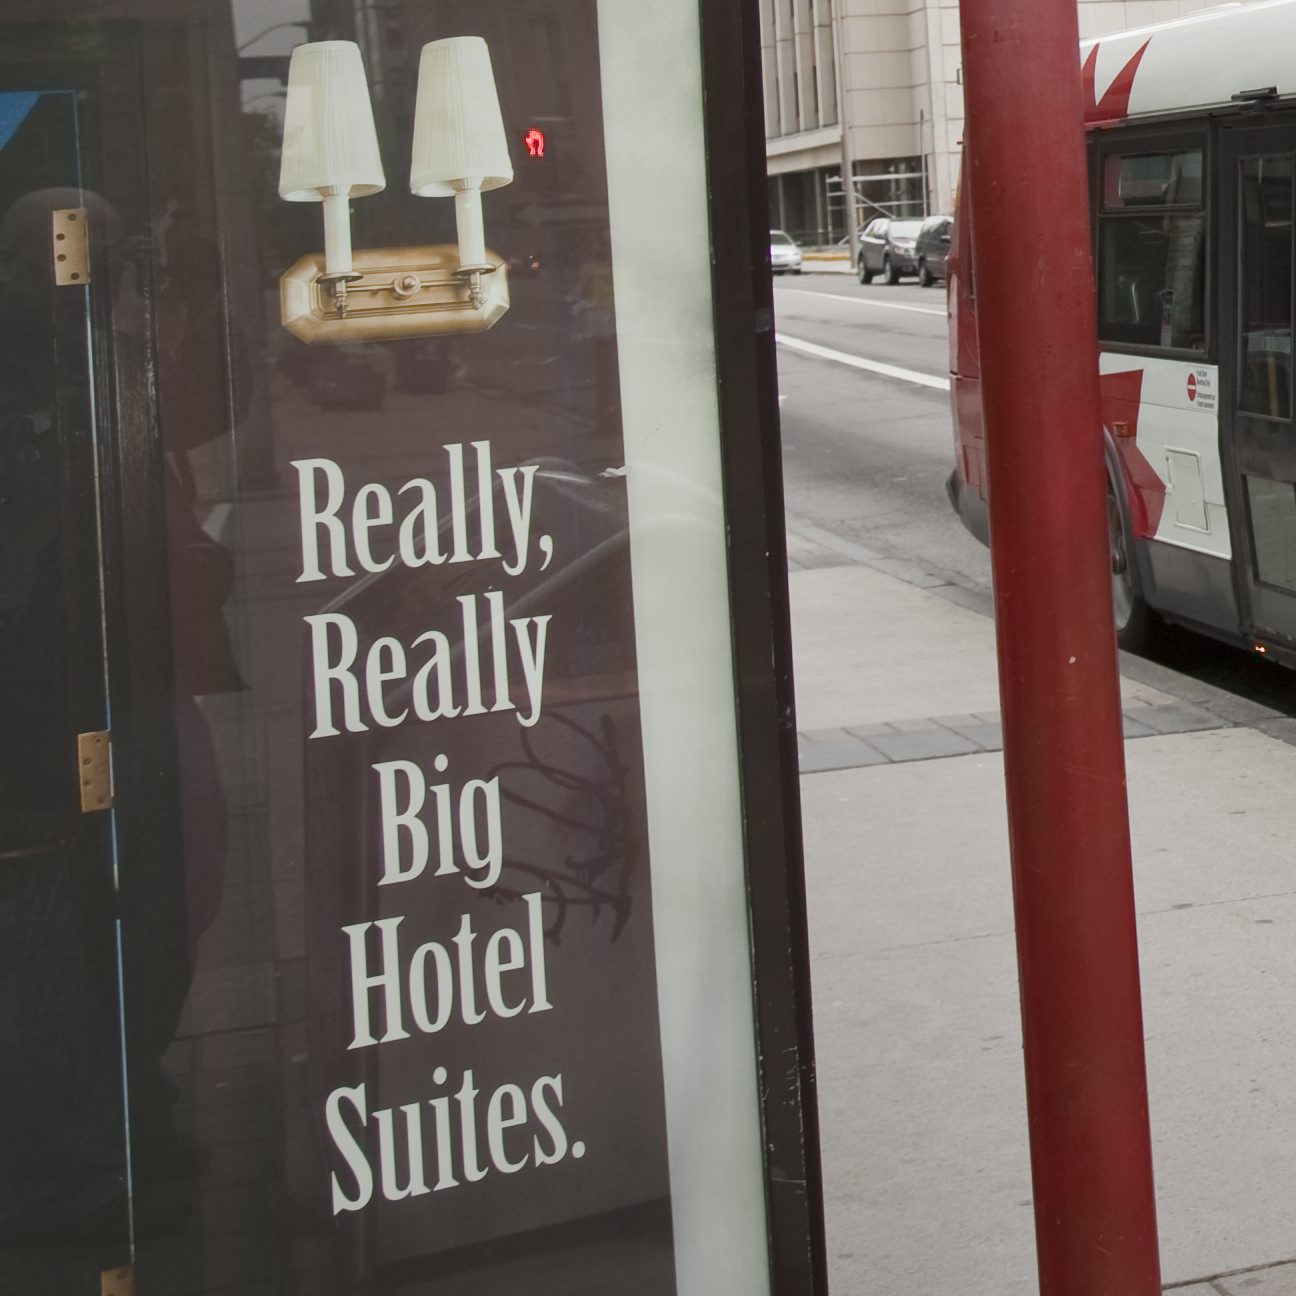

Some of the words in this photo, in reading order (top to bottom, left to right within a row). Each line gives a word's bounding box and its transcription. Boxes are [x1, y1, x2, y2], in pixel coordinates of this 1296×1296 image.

[291, 440, 554, 583] Really,
[303, 591, 553, 739] Really
[371, 753, 502, 889] Big
[341, 892, 555, 1051] Hotel
[324, 1066, 586, 1216] Suites.
